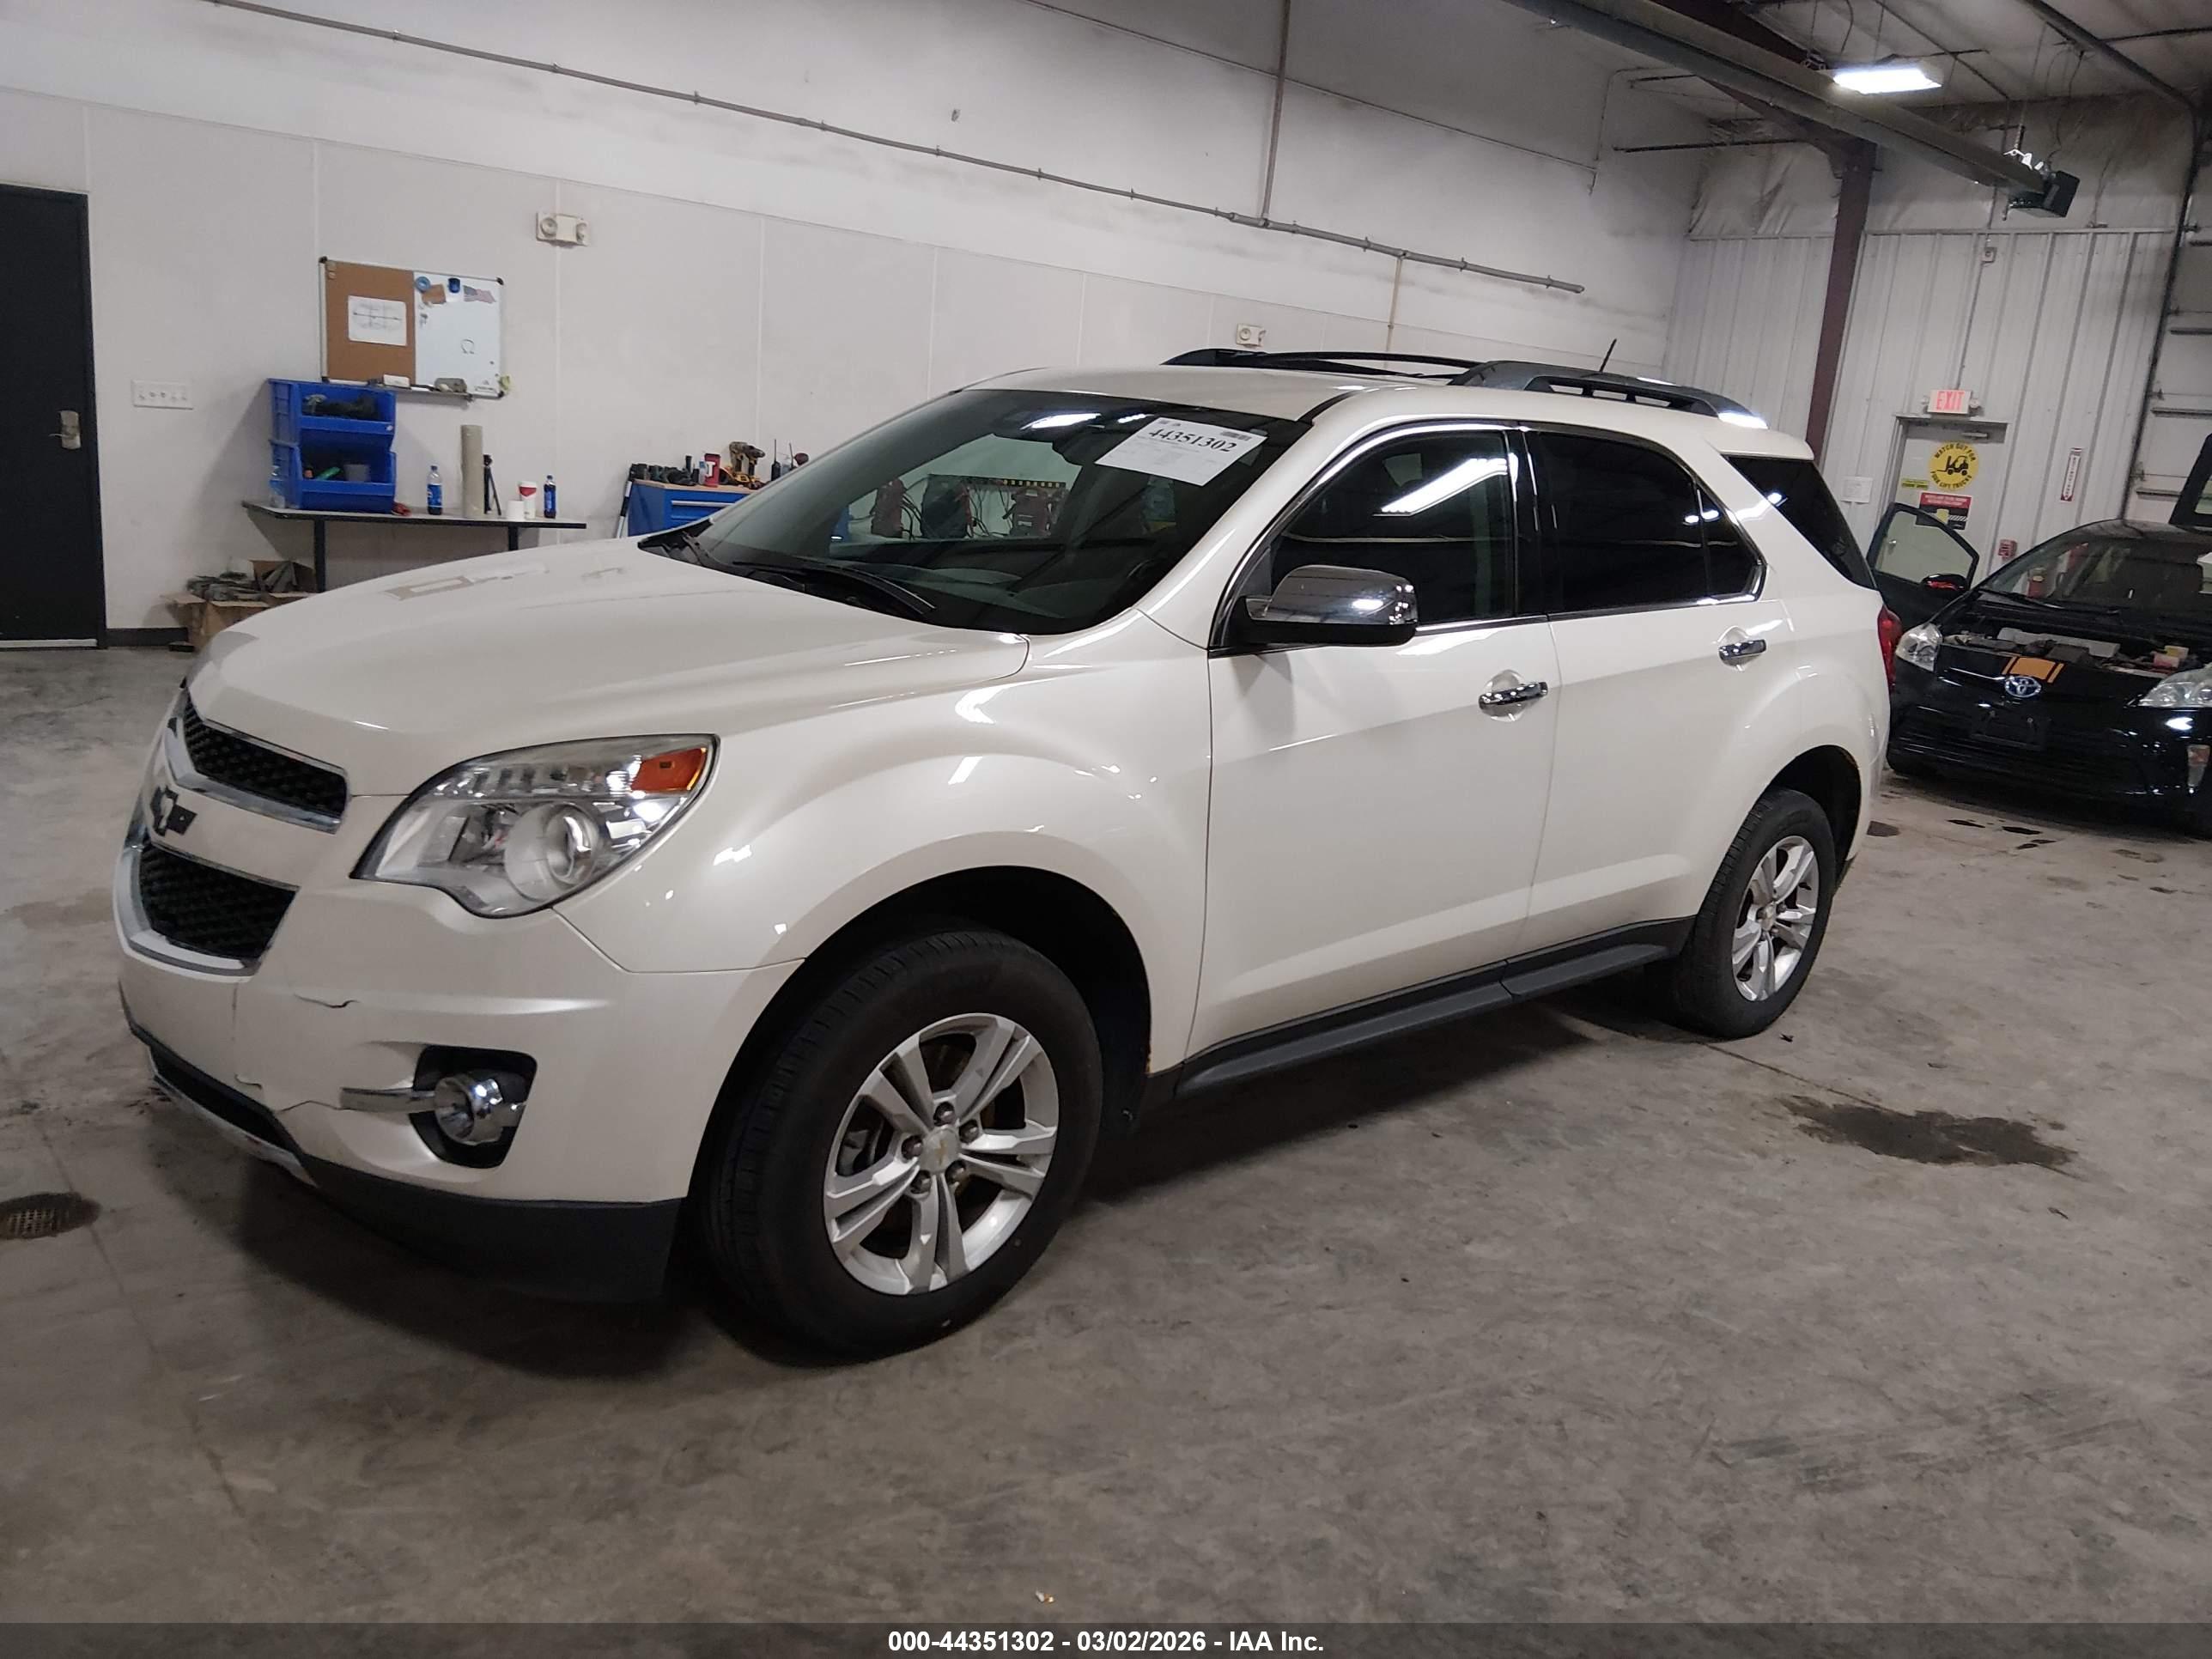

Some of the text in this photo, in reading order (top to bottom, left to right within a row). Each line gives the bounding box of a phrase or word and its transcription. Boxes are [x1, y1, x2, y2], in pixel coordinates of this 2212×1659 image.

[1936, 391, 1966, 410] EXIT
[1148, 428, 1237, 453] 44351302
[1934, 443, 1954, 459] WATCH
